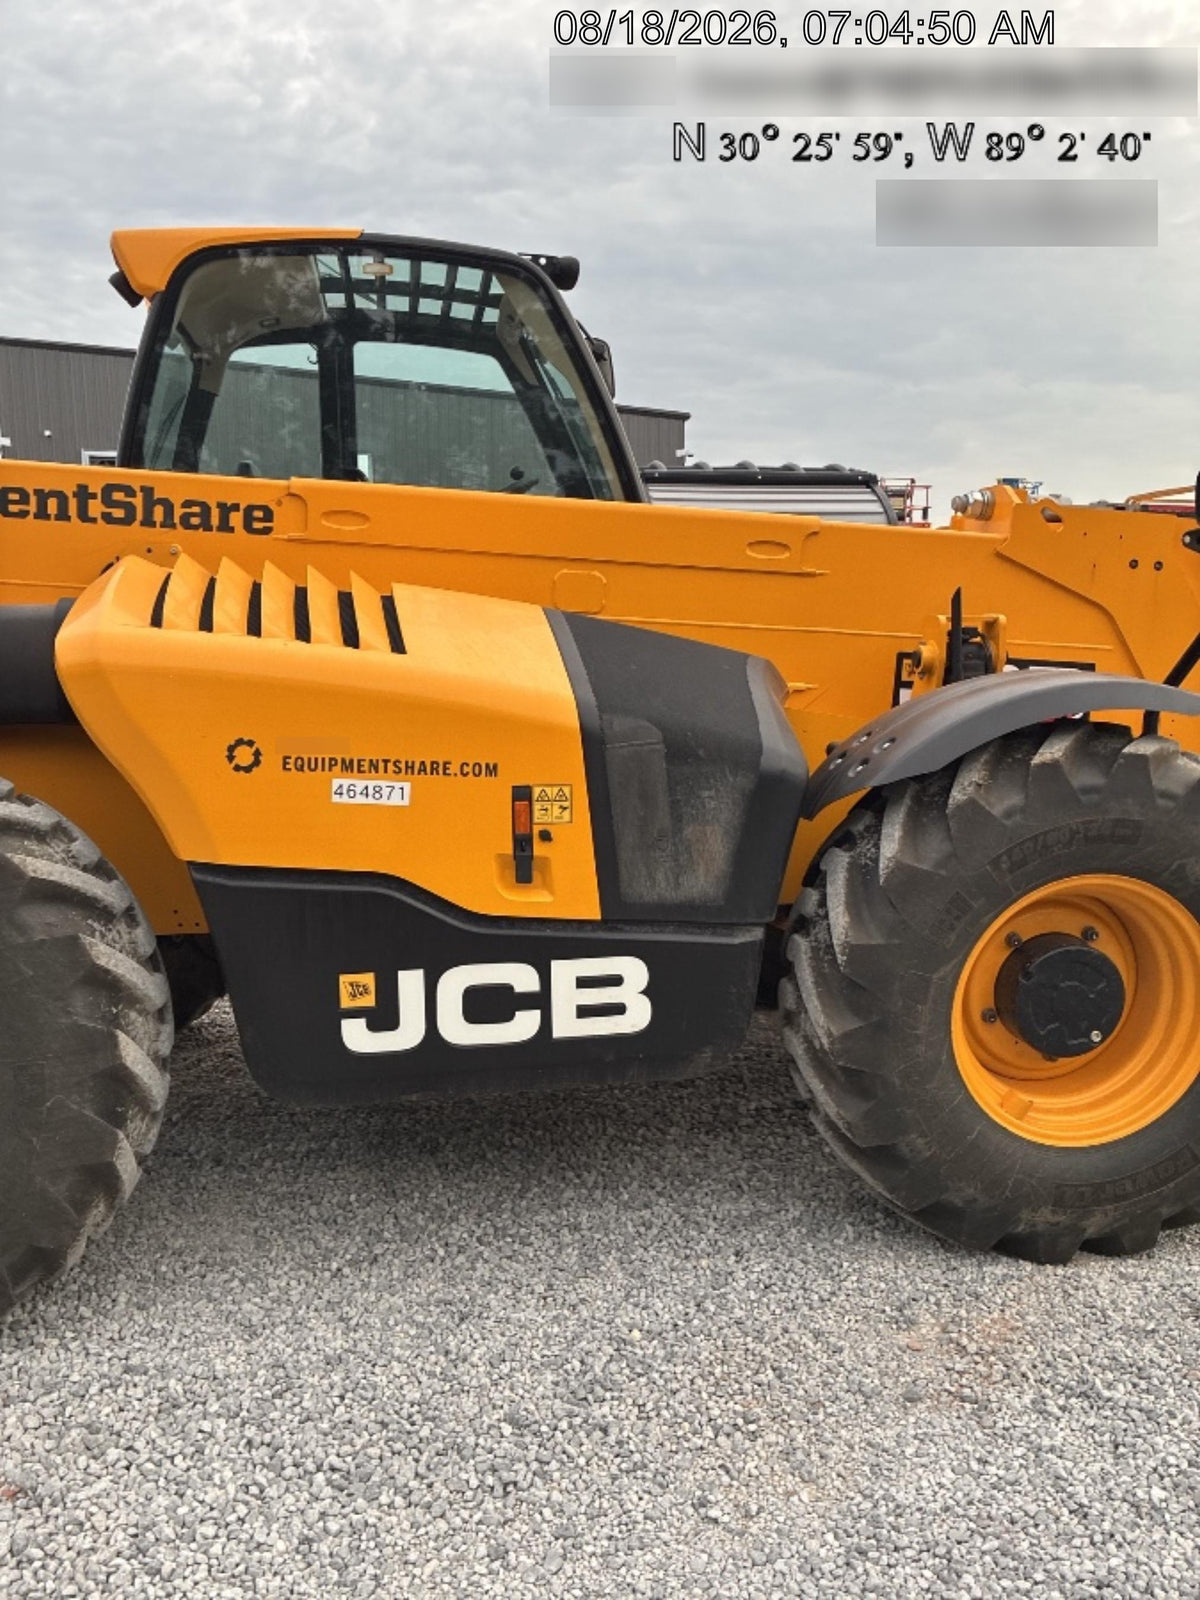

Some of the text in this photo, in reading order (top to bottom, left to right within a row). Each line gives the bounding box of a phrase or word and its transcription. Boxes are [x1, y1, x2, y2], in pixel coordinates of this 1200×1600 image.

[0, 482, 274, 536] entShare
[281, 755, 499, 778] EQUIPMENTSHARE.COM
[333, 783, 406, 801] 464871
[340, 956, 652, 1054] JCB
